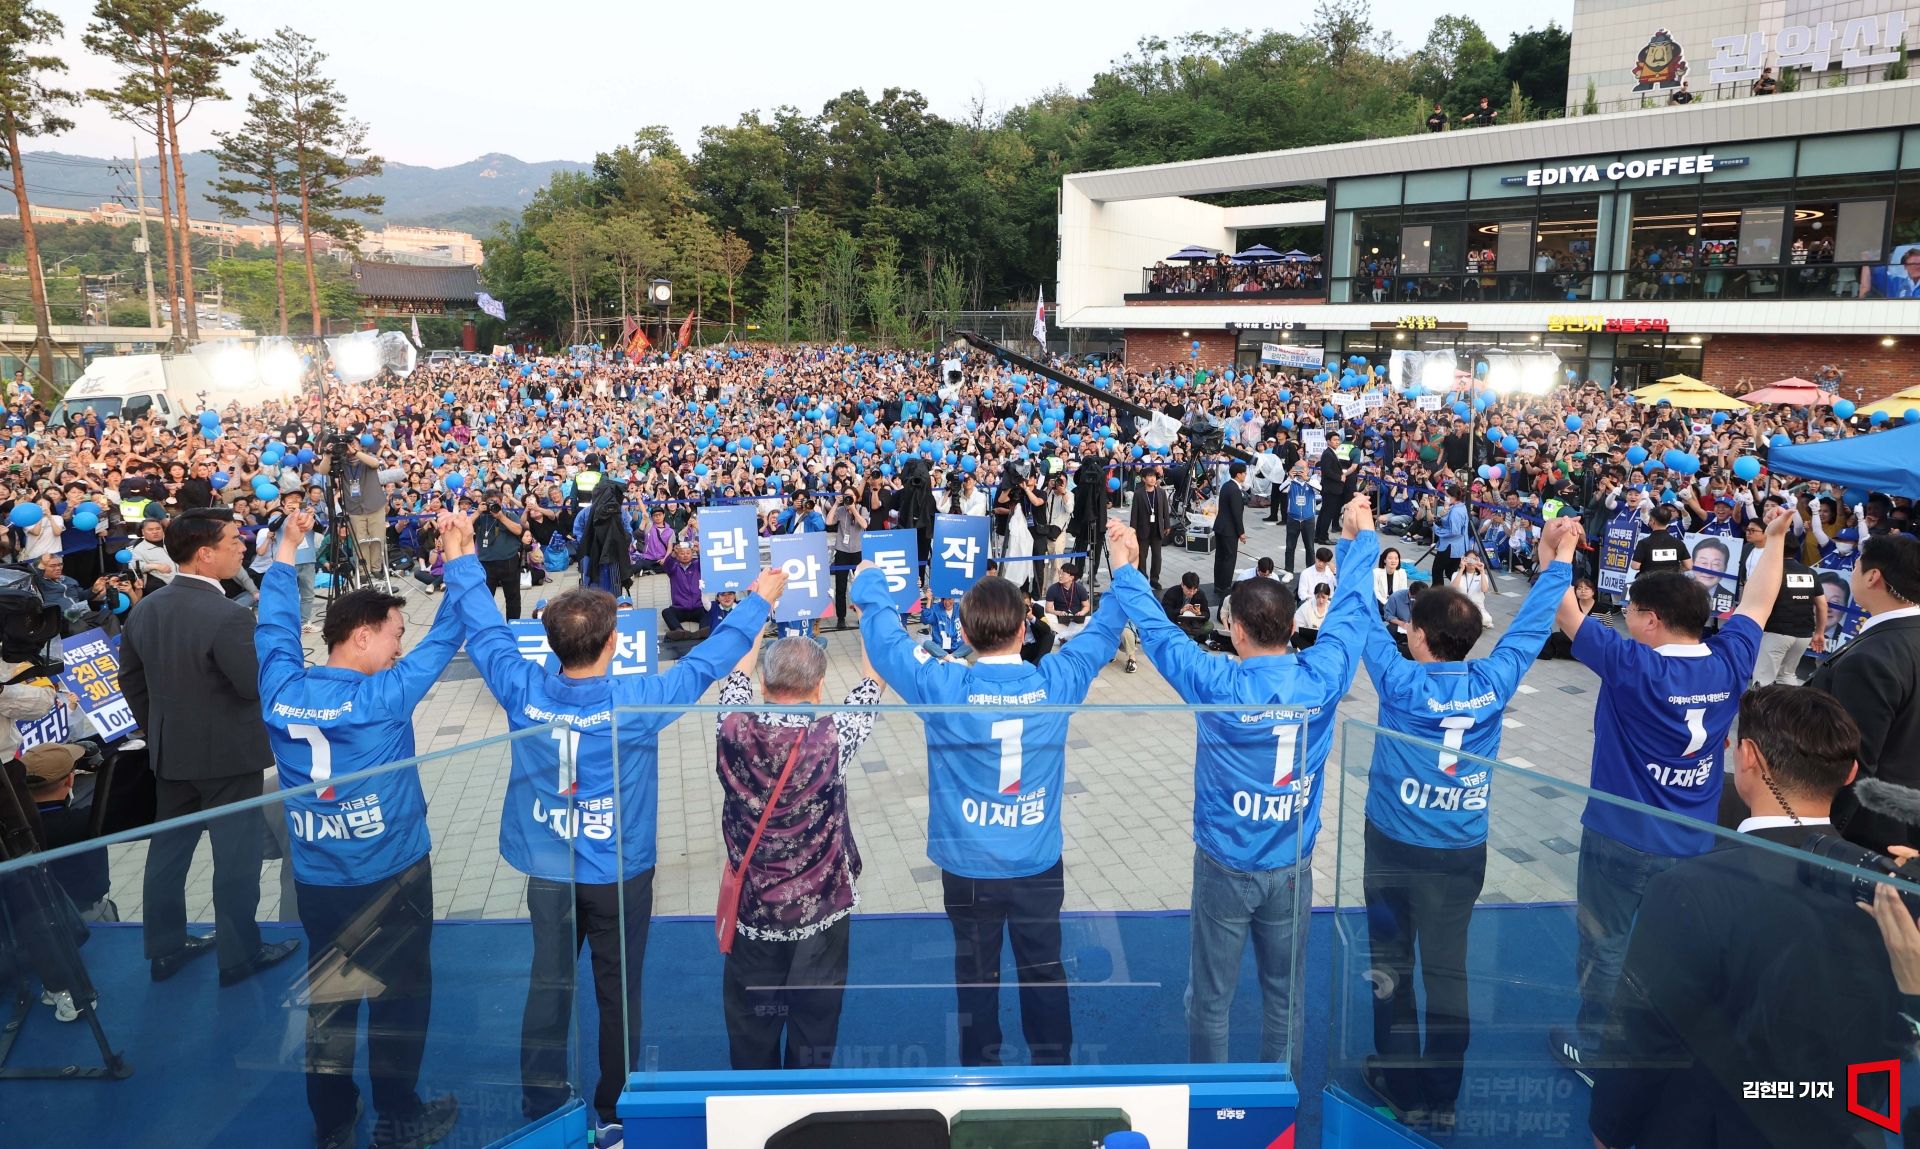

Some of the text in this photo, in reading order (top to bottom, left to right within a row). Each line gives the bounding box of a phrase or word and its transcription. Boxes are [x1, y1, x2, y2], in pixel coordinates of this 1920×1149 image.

[1709, 10, 1909, 84] 관악산
[1526, 154, 1715, 186] EDIYA COFFEE
[1605, 318, 1669, 333] 전통주막
[706, 527, 749, 572] 관
[1607, 528, 1633, 540] 사전투표
[781, 554, 821, 598] 악
[874, 550, 911, 593] 동
[940, 536, 981, 579] 작
[612, 630, 648, 676] 천
[967, 688, 1048, 705] 이제부터 진짜 대한민국
[1438, 716, 1476, 776] 1
[1680, 707, 1708, 758] 1
[287, 723, 336, 800] 1
[551, 727, 581, 796] 1
[991, 718, 1024, 794] 1
[1271, 723, 1301, 787] 1
[1400, 777, 1489, 811] 이재명
[1460, 771, 1488, 787] 지금은
[290, 805, 386, 842] 이재명
[338, 793, 380, 812] 지금은
[577, 797, 614, 811] 지금은
[961, 798, 1046, 828] 이재명
[1216, 1109, 1246, 1120] 민주당
